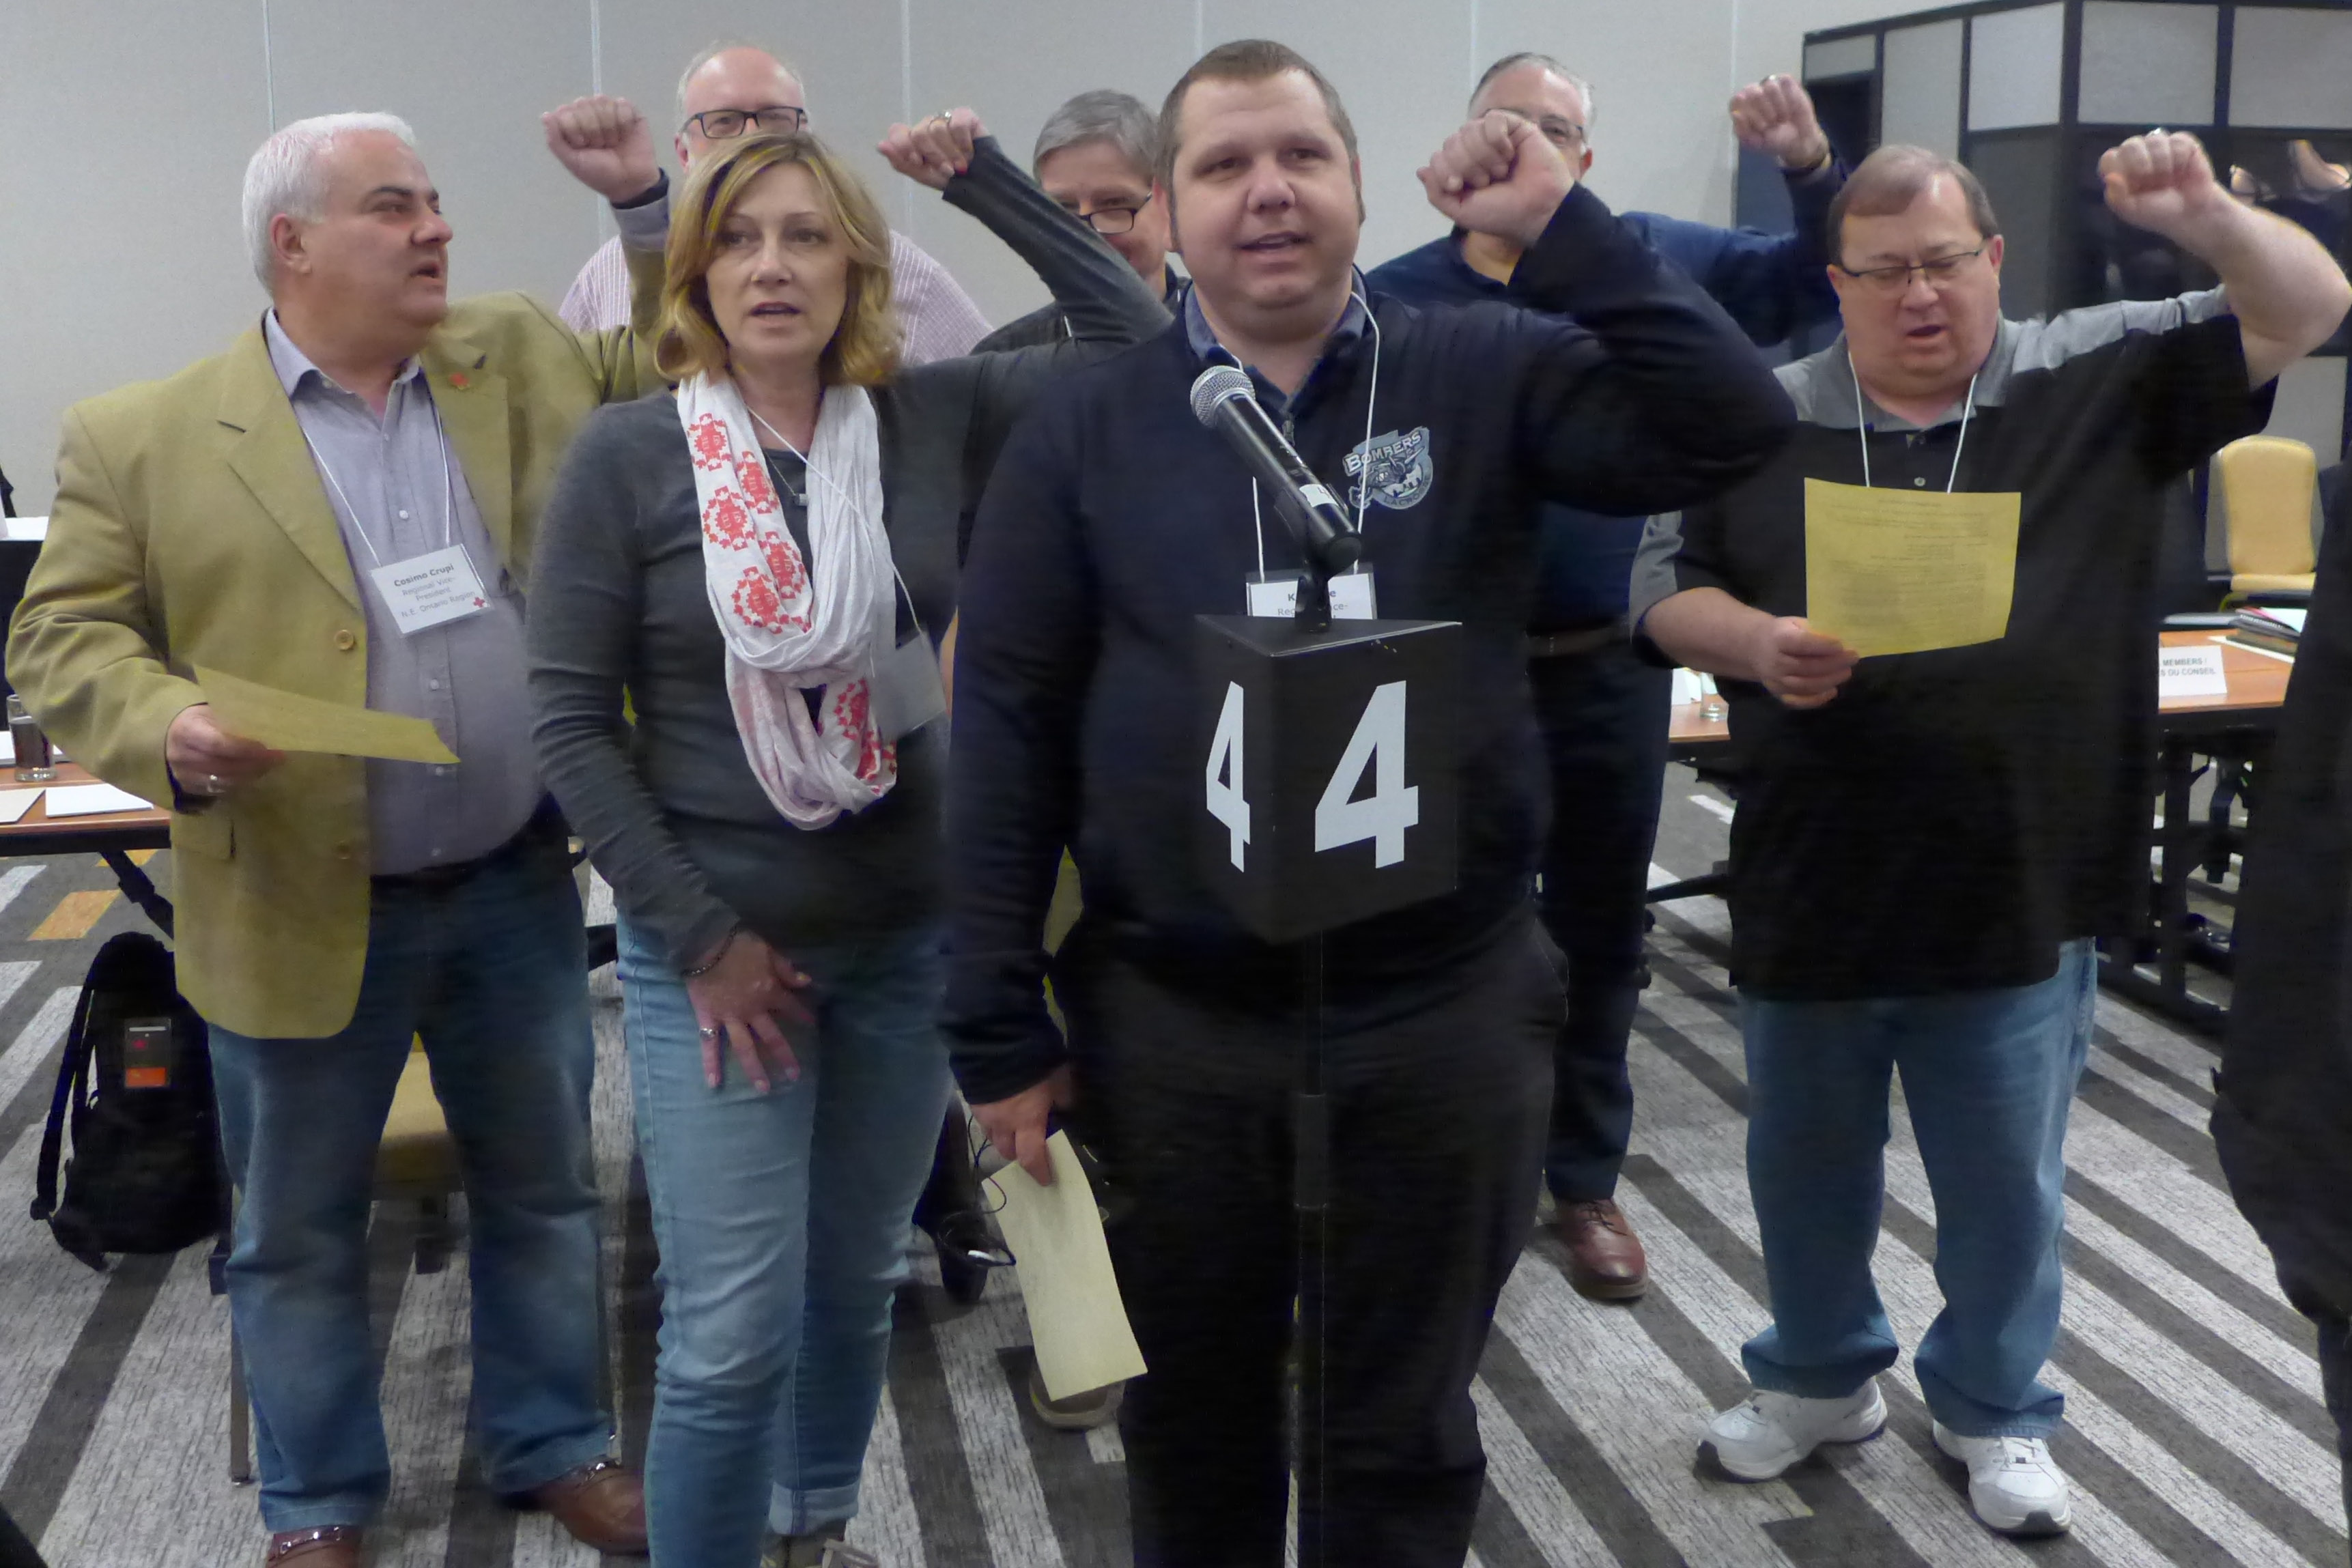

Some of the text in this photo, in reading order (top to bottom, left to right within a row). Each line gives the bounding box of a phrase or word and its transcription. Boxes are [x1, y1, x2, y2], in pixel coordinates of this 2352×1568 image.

[1345, 430, 1422, 472] BOMBERS
[394, 563, 454, 586] Cosimo Crupi
[416, 587, 451, 601] President
[419, 600, 449, 612] Ontario
[449, 591, 475, 603] Region
[2163, 657, 2202, 666] MEMBERS
[2168, 668, 2179, 676] DU
[2181, 668, 2216, 676] CONSEIL
[1206, 681, 1250, 872] 4
[1315, 680, 1419, 868] 4
